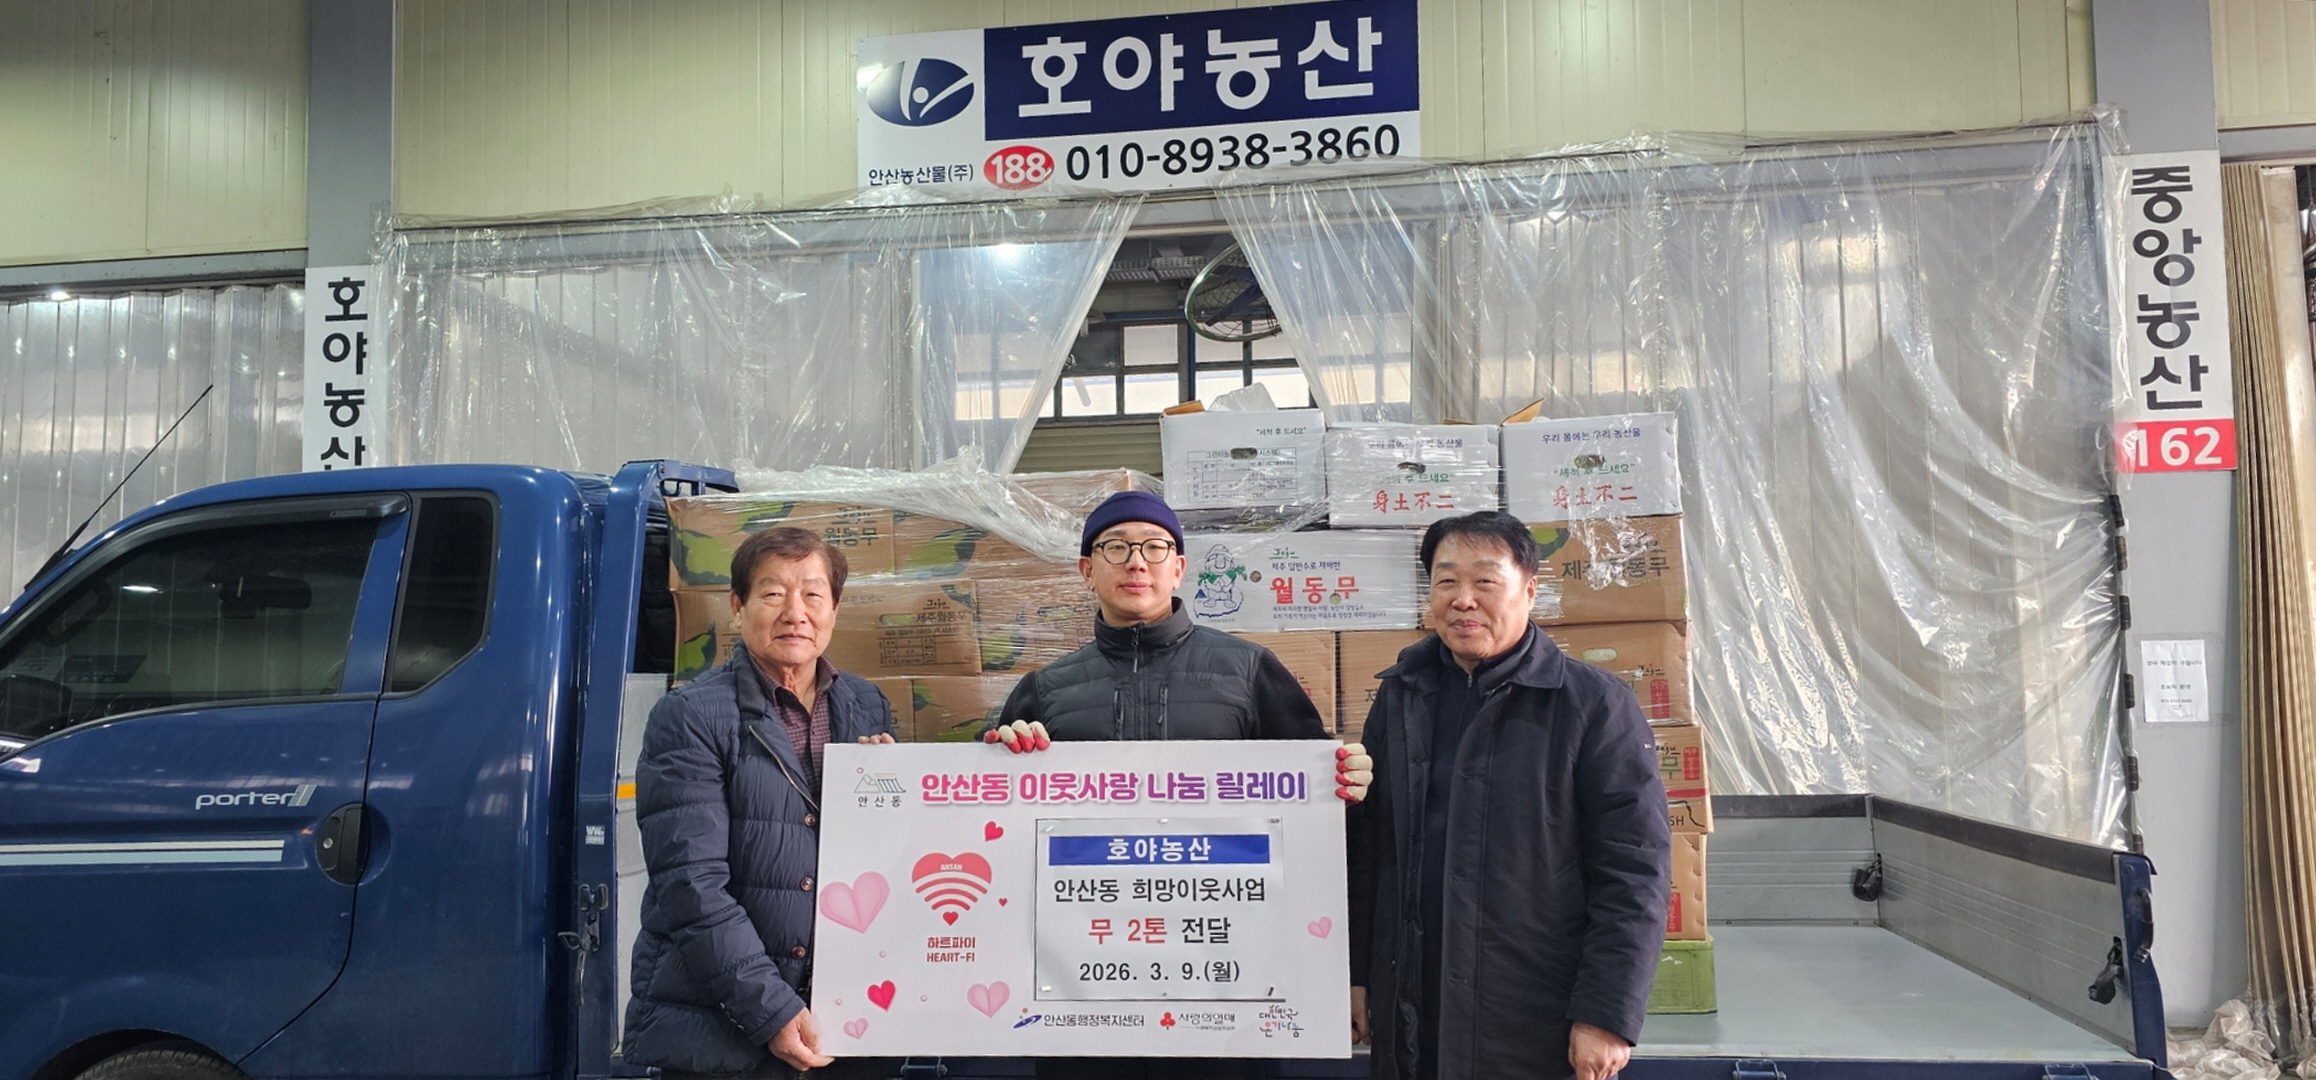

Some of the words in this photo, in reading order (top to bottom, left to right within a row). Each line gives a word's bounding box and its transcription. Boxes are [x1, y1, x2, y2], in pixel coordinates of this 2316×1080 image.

[1017, 17, 1383, 117] 호야농산
[1066, 124, 1400, 181] 010-8938-3860
[869, 164, 974, 186] 안산농산물(주)
[991, 153, 1047, 184] 188
[2131, 165, 2209, 410] 중앙농산
[1542, 433, 1560, 444] 우리
[1563, 432, 1590, 443] 몸에는
[1613, 427, 1641, 439] 농산물
[2135, 426, 2222, 467] 162
[1373, 490, 1454, 514] 身土不二
[1553, 484, 1638, 510] 身土不二
[1272, 562, 1286, 571] 제주
[926, 598, 947, 610] Jeju
[922, 773, 1009, 801] 안산동
[1019, 772, 1138, 800] 이웃사랑
[1148, 772, 1205, 800] 나눔
[1216, 772, 1305, 800] 릴레이
[1107, 837, 1211, 862] 호야농산
[940, 863, 963, 871] ANSAN
[1054, 878, 1120, 903] 안산동
[1132, 877, 1266, 902] 희망이웃사업
[1088, 918, 1113, 944] 무
[1127, 917, 1168, 944] 2톤
[1181, 916, 1231, 944] 전달
[927, 936, 976, 949] 하트파이
[926, 952, 975, 962] HEART-FI
[1079, 963, 1138, 981] 2026.
[1150, 963, 1169, 981] 3.
[1044, 1014, 1145, 1027] 안산동행정복지센터
[1178, 1012, 1235, 1025] 사랑의열매
